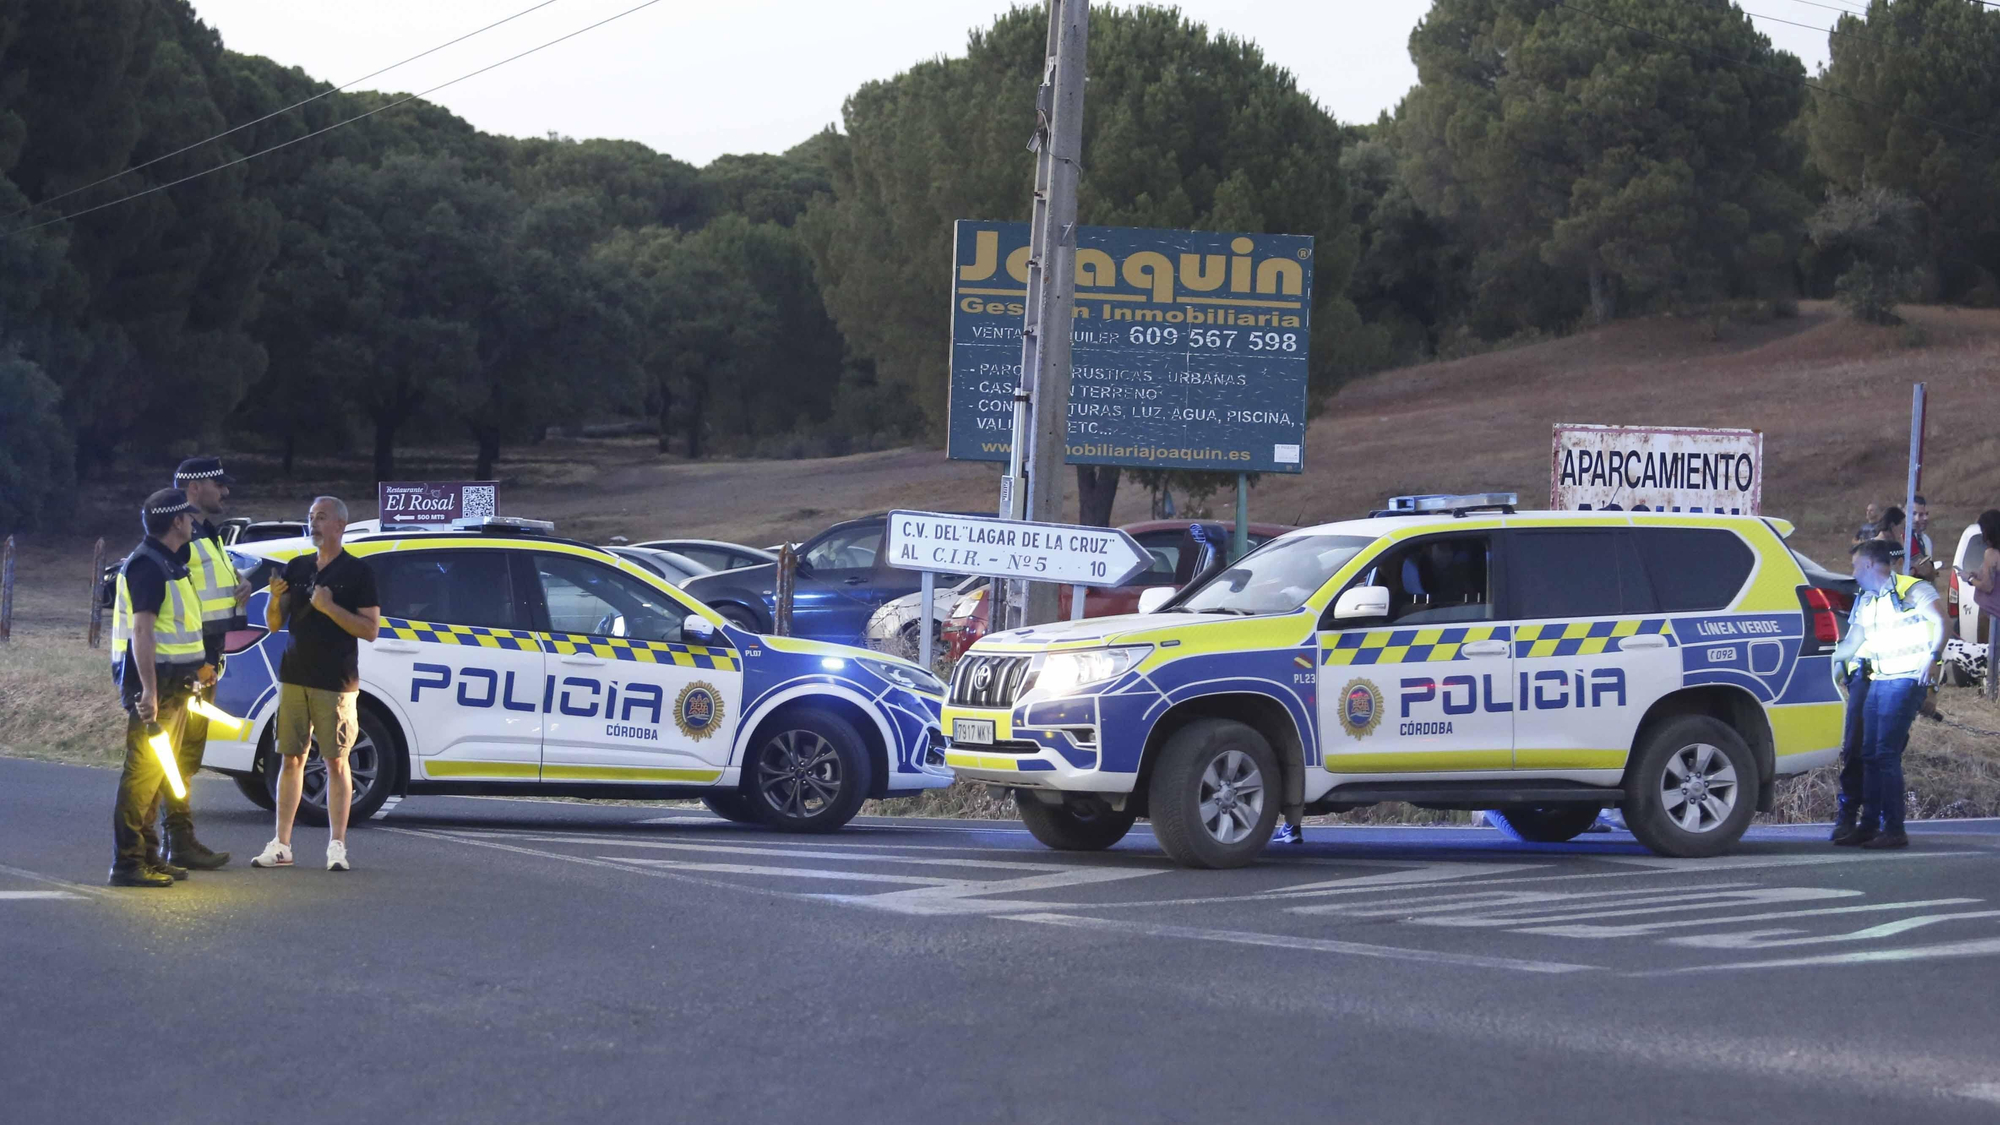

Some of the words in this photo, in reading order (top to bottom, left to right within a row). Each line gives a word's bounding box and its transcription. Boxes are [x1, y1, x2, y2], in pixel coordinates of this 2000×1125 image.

[960, 297, 1089, 319] Gesn
[1103, 304, 1301, 328] Inmobiliaria
[1129, 326, 1178, 346] 609
[1189, 329, 1238, 348] 567
[1248, 332, 1297, 352] 598
[1168, 371, 1247, 386] URBANAS
[1080, 385, 1157, 401] TERRENO
[1227, 411, 1295, 427] PISCINA,
[1560, 449, 1752, 492] APARCAMIENTO
[386, 486, 424, 494] Restaurante
[385, 494, 405, 511] El
[408, 493, 455, 511] Rosal
[903, 521, 928, 539] C.V.
[934, 524, 960, 541] DEL
[1022, 531, 1040, 549] DE
[1045, 533, 1063, 551] LA
[901, 543, 918, 560] AL
[932, 547, 980, 566] C.I.R.
[1090, 560, 1107, 577] 10
[1696, 620, 1738, 636] LÍNEA
[1736, 620, 1782, 634] VERDE
[1294, 673, 1316, 684] PL23
[606, 723, 658, 741] CÓRDOBA
[958, 723, 975, 741] 7917
[1400, 721, 1453, 736] CÓRDOBA
